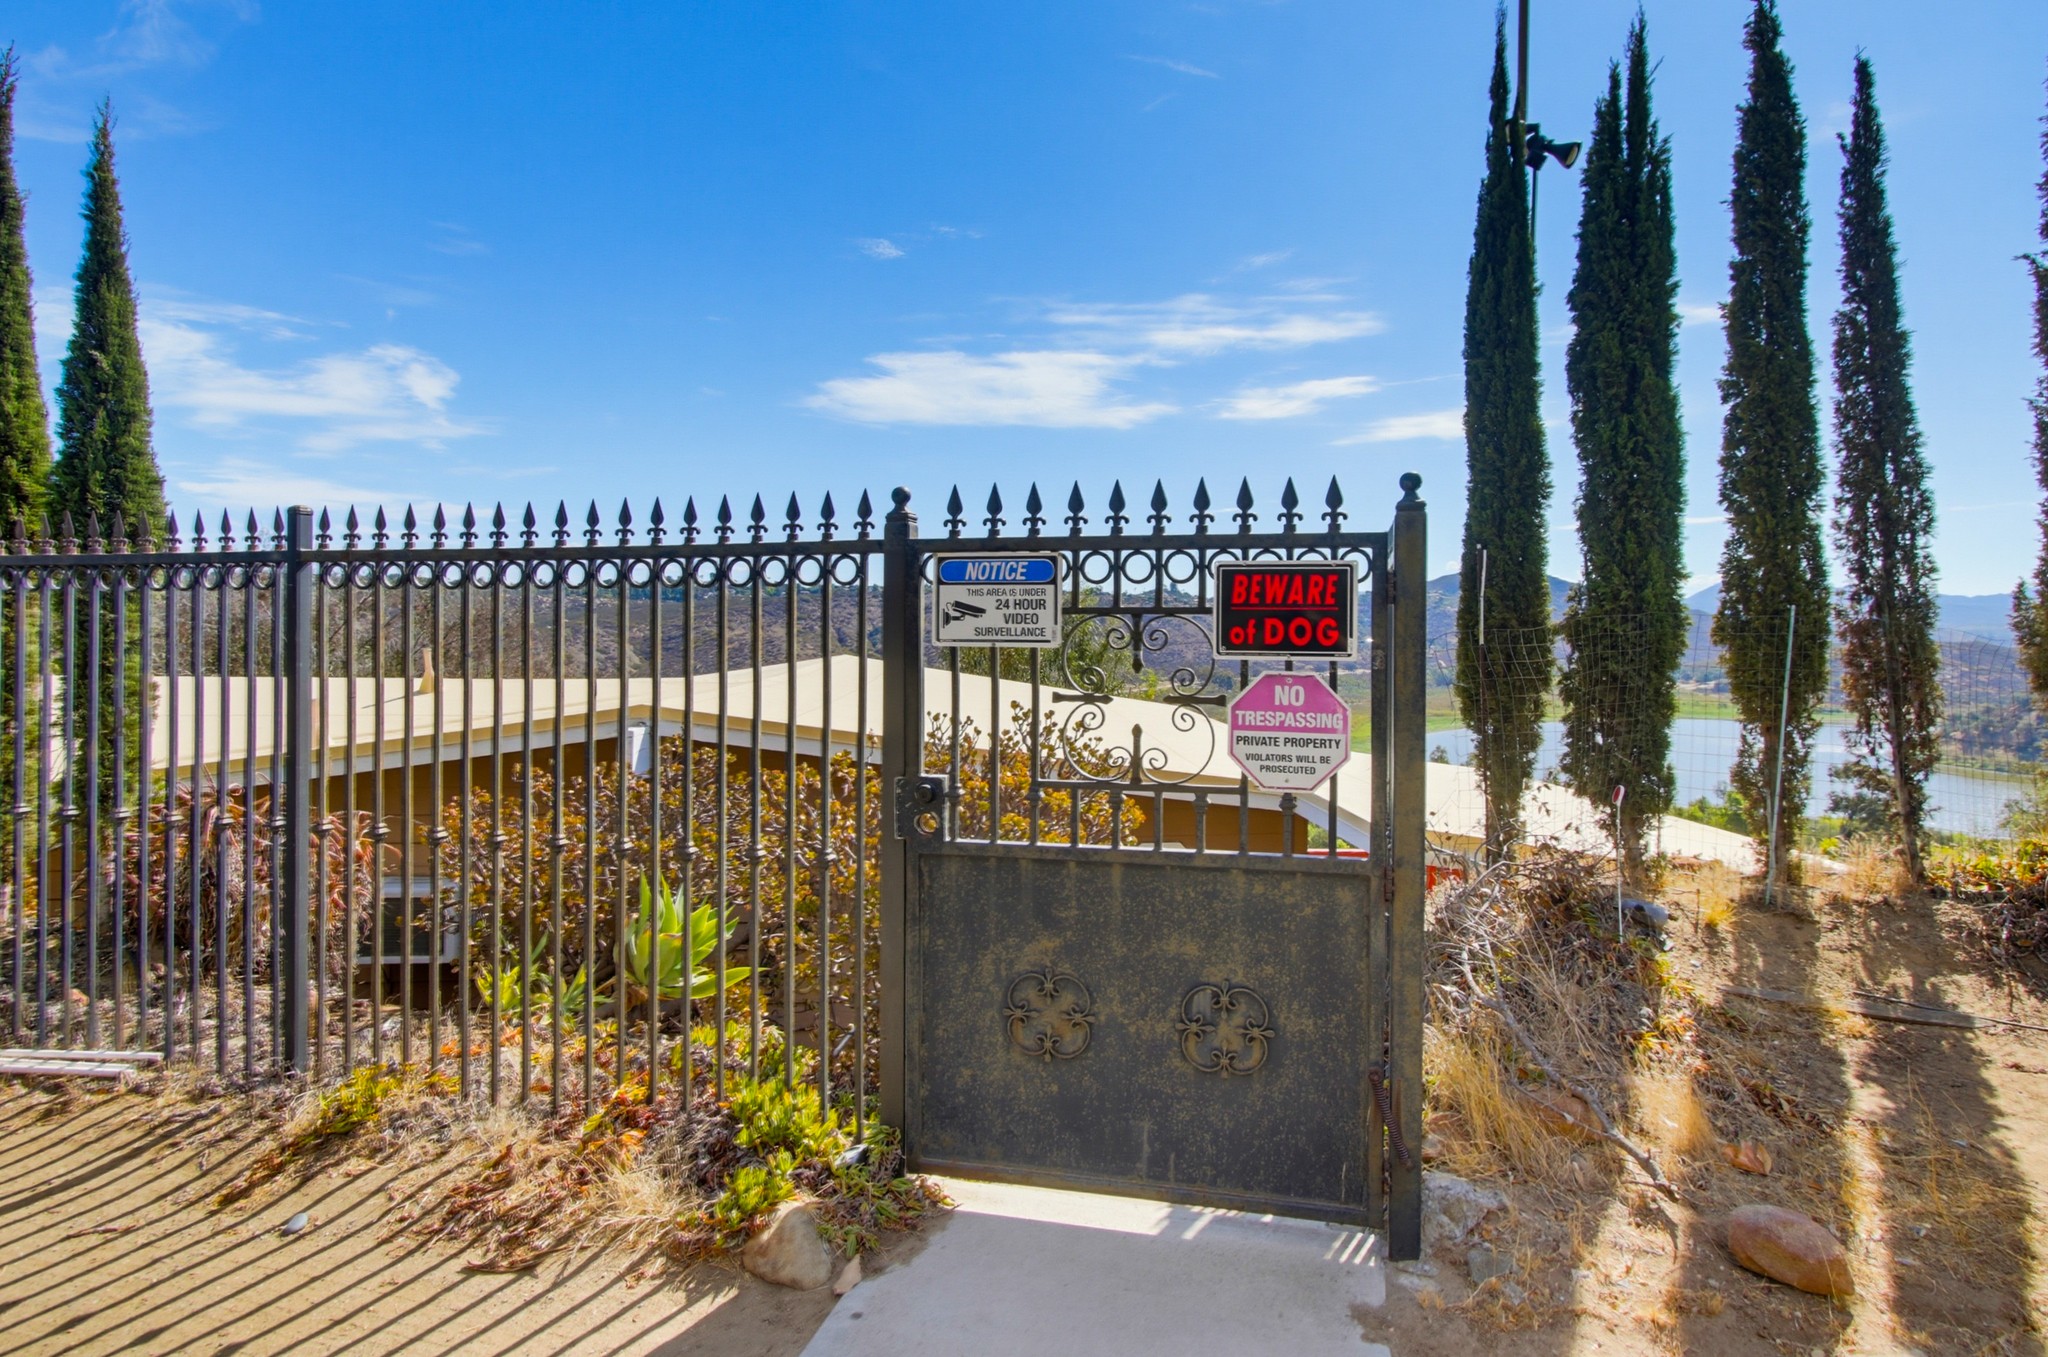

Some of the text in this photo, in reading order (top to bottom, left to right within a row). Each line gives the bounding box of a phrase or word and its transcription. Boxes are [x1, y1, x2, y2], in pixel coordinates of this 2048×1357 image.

[965, 562, 1029, 580] NOTICE
[967, 588, 1047, 597] THIS AREA IS UNDER
[1231, 574, 1339, 605] BEWARE
[995, 599, 1047, 610] 24 HOUR
[1003, 613, 1039, 625] VIDEO
[974, 627, 1046, 637] SURVEILLANCE
[1229, 618, 1256, 645] of
[1263, 616, 1340, 647] DOG
[1274, 685, 1305, 706] NO
[1236, 711, 1343, 729] TRESPASSING
[1236, 735, 1341, 749] PRIVATE PROPERTY
[1245, 753, 1331, 764] VIOLATORS WILL BE
[1260, 765, 1316, 775] PROSECUTED
